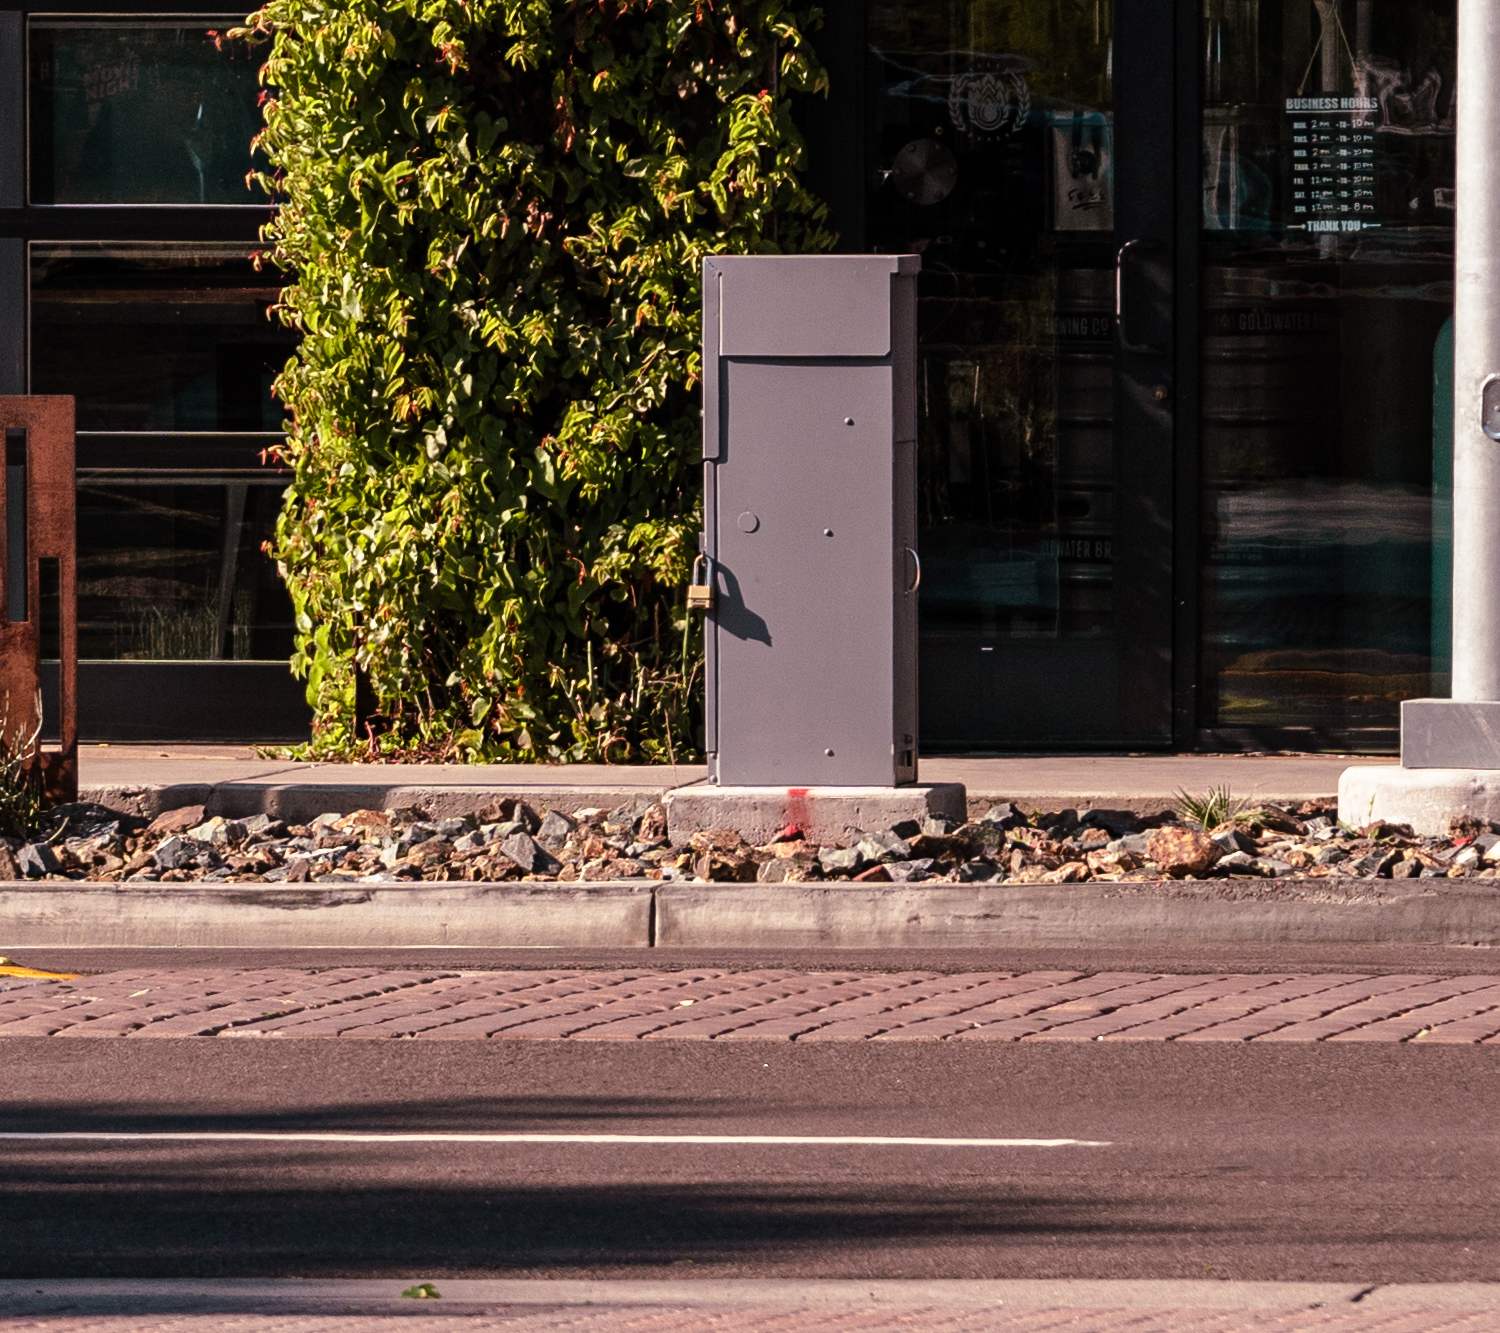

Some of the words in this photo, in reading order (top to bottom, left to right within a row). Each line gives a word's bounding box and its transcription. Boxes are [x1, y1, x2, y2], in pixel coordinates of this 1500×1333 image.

[1285, 98, 1338, 110] BUSINESS
[1341, 97, 1378, 110] HOURS
[1306, 220, 1339, 232] THANK
[1341, 220, 1361, 232] YOU
